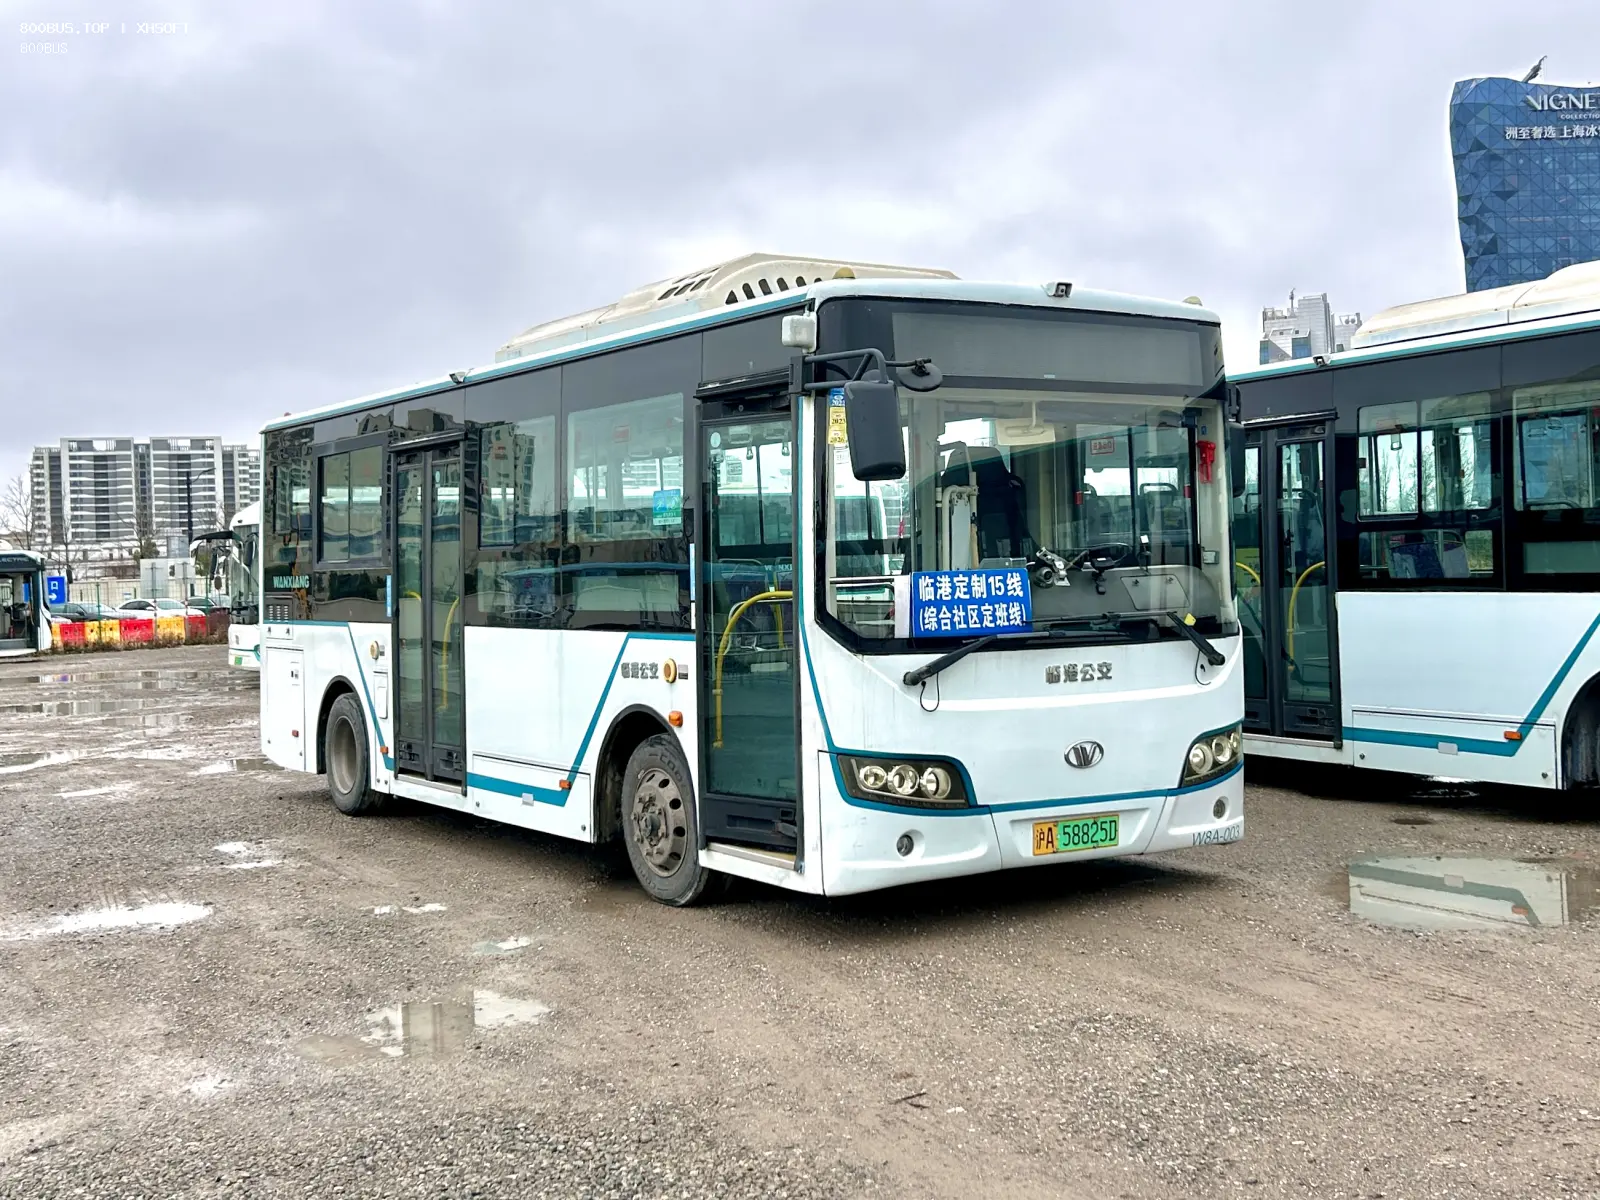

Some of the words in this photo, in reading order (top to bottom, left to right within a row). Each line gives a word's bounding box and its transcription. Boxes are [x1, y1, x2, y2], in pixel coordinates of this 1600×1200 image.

[1526, 92, 1600, 111] VIGNE
[1559, 124, 1600, 139] 上海冰
[272, 575, 310, 589] WANXIANG
[918, 572, 1024, 602] 临港定制15线
[919, 602, 1026, 632] (综合社区定班线)
[1062, 819, 1118, 847] 58825D
[1192, 824, 1240, 846] W8A-003
